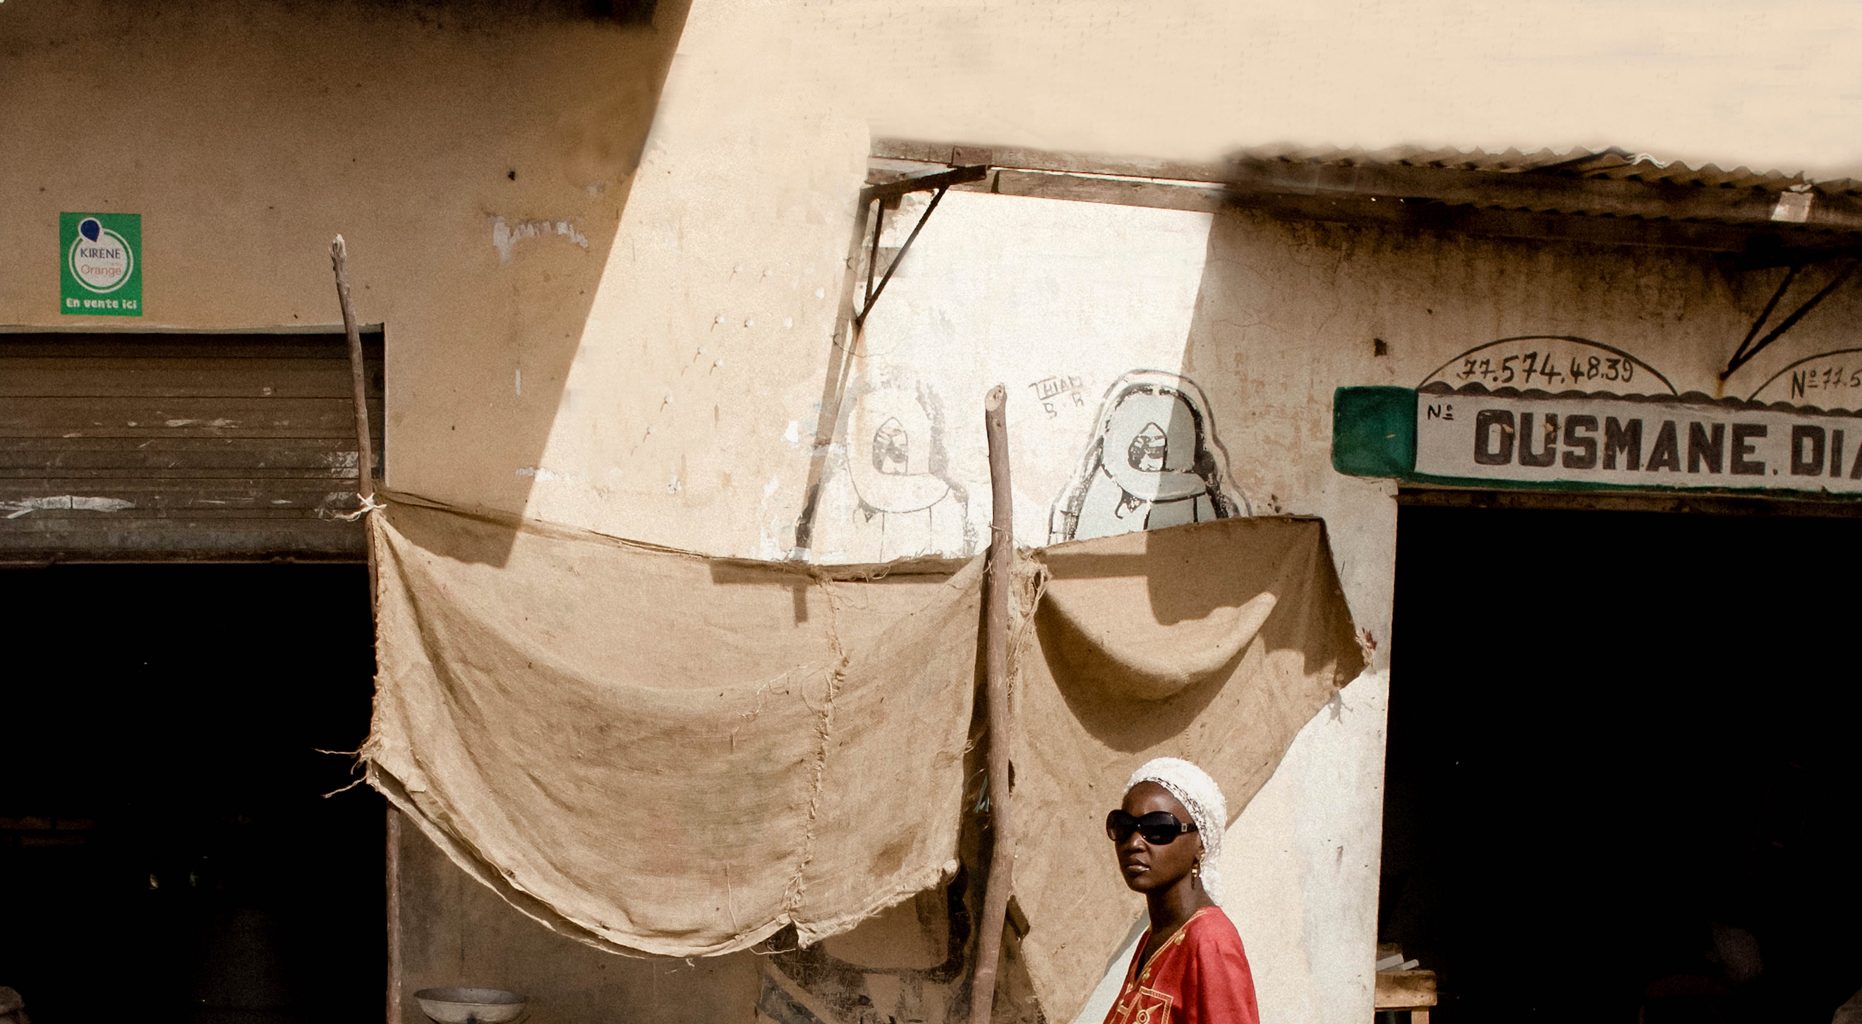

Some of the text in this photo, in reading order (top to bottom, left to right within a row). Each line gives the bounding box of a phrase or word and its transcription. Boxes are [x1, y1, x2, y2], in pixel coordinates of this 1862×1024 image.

[81, 264, 122, 277] Orange
[66, 298, 137, 310] En vente ici
